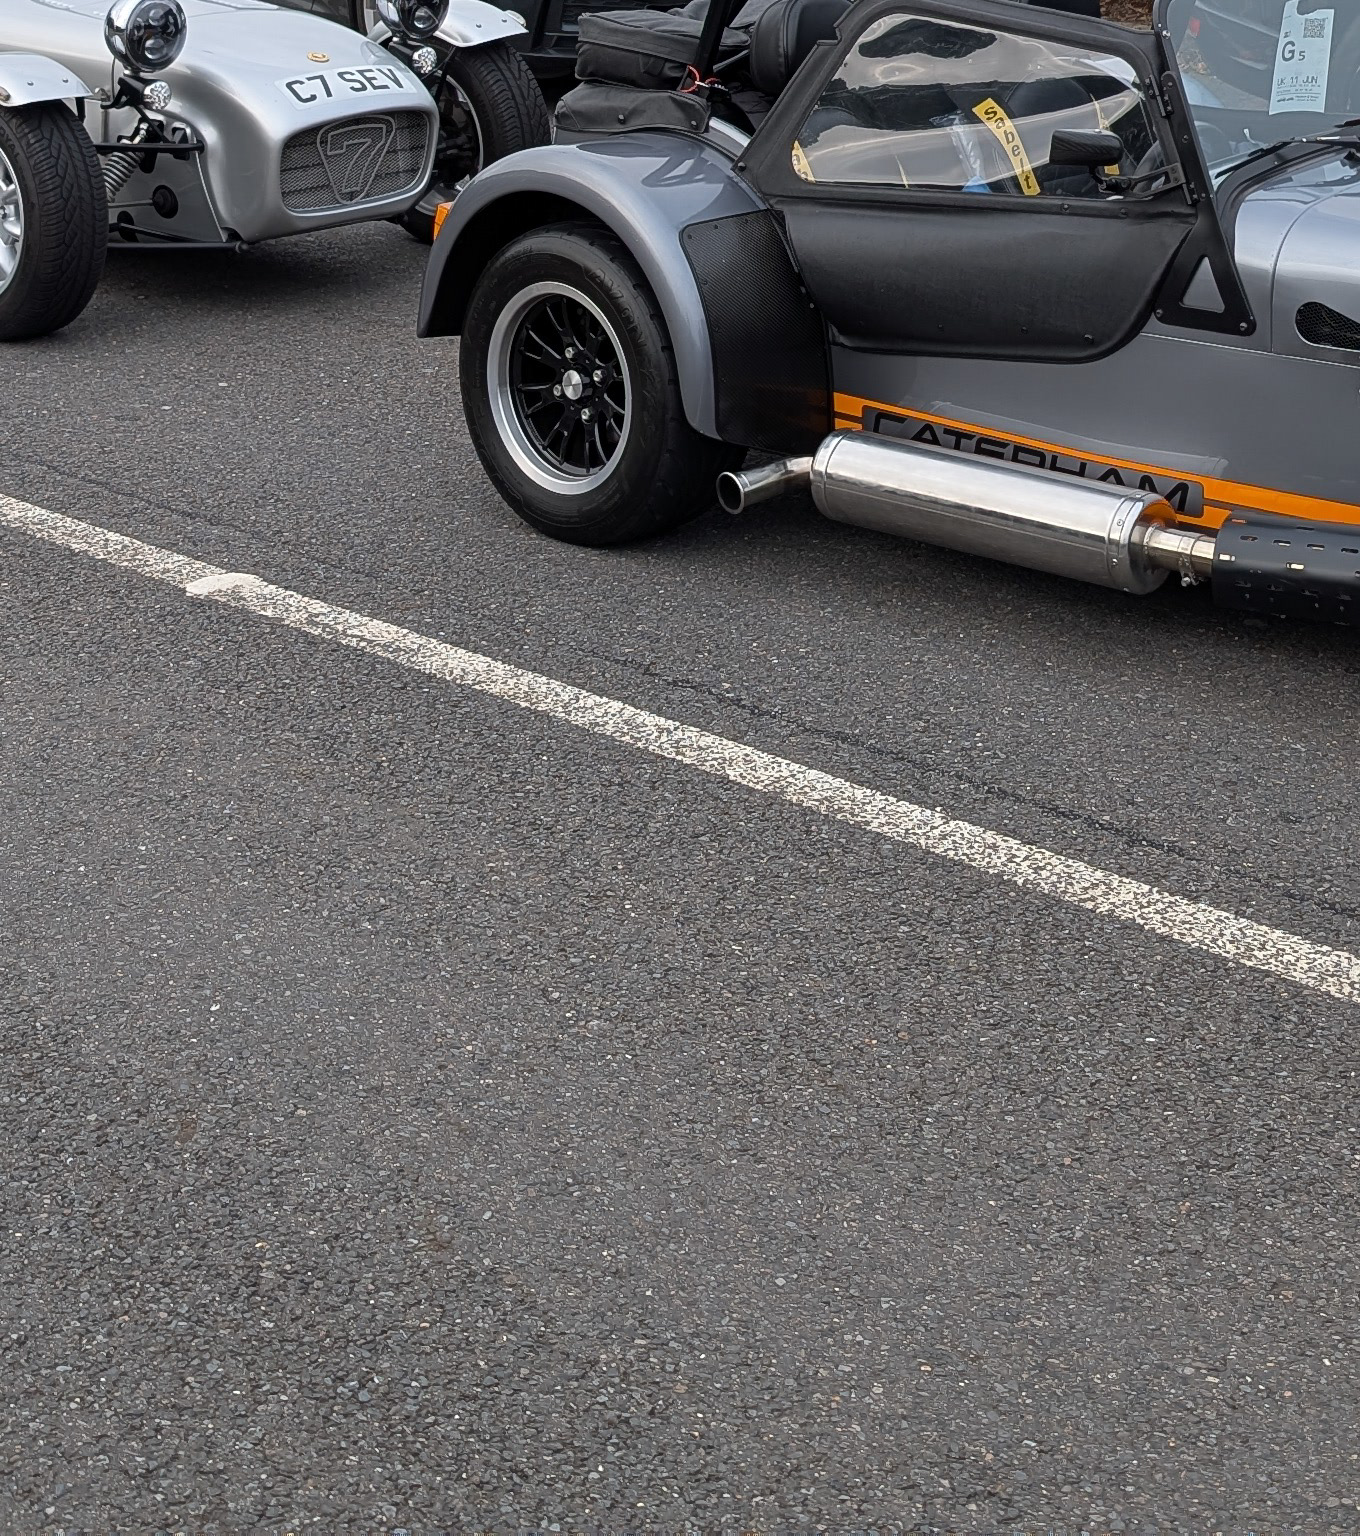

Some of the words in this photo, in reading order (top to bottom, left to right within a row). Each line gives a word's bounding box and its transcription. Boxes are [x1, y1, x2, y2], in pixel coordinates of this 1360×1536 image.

[1281, 40, 1296, 62] G
[1297, 50, 1306, 62] 5
[285, 74, 333, 104] C7
[336, 68, 404, 93] SEV
[1302, 75, 1319, 85] JUN
[326, 123, 387, 194] 7
[983, 106, 1032, 190] Sabelt
